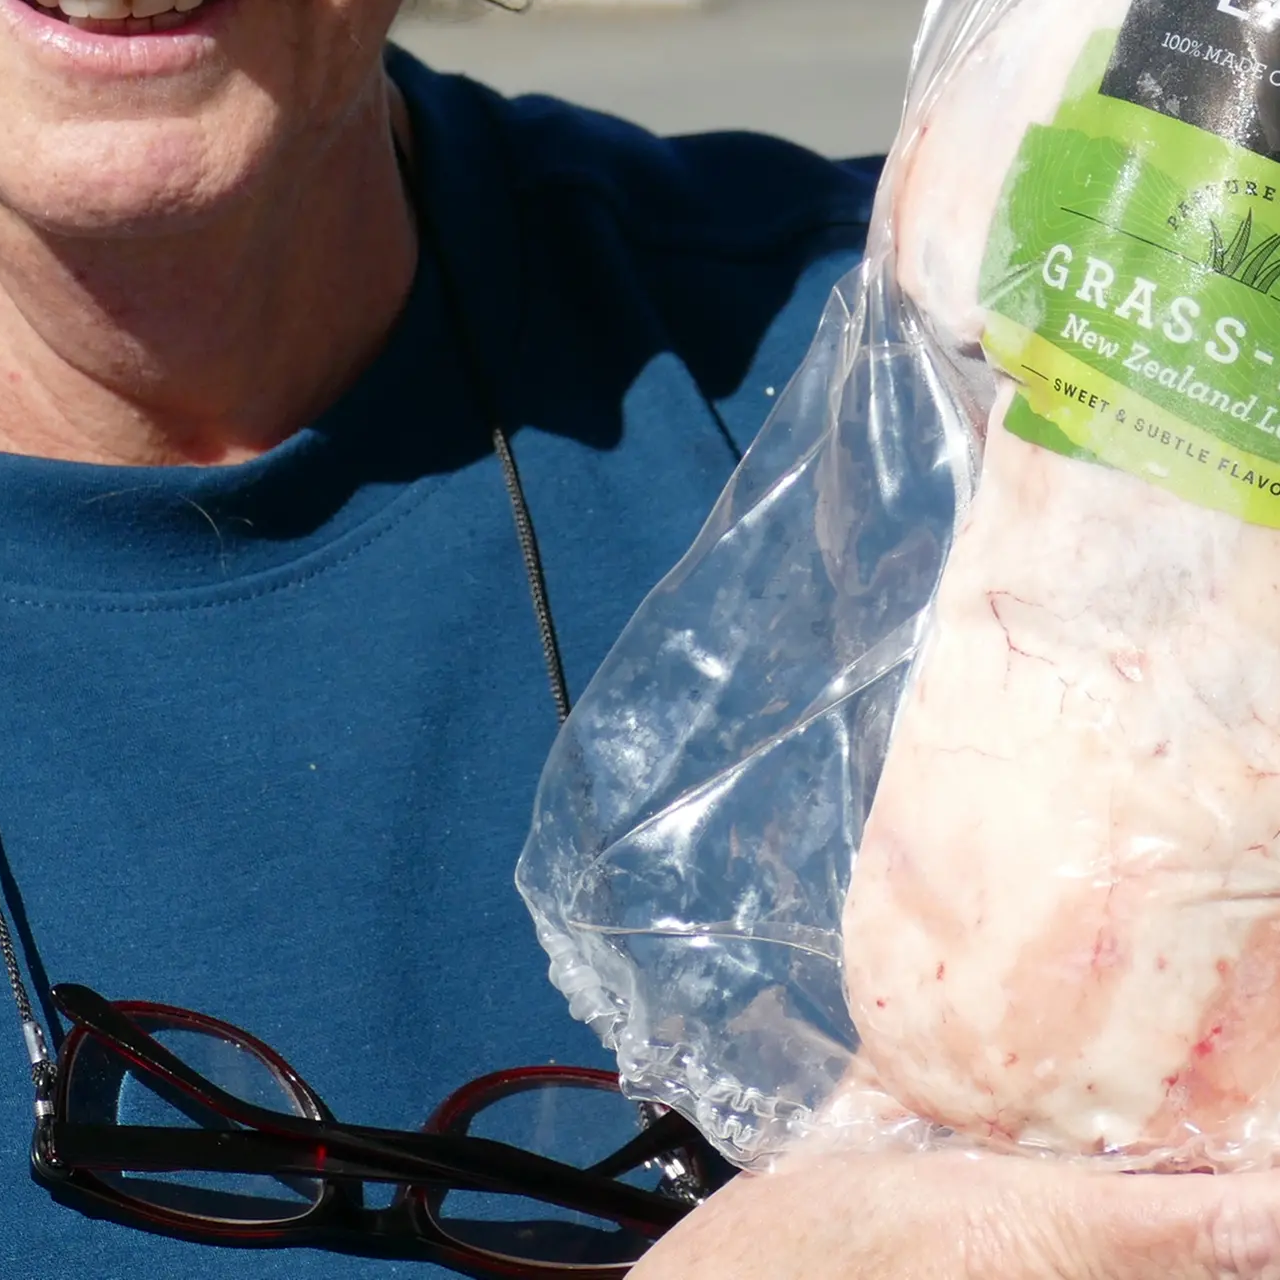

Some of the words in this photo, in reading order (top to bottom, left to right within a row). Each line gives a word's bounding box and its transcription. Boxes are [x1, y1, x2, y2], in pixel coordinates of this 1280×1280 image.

[1161, 32, 1204, 57] 100%
[1203, 45, 1268, 80] MADE
[1060, 312, 1120, 359] New
[1122, 341, 1259, 424] Zealand
[1053, 378, 1110, 413] SWEET
[1115, 408, 1128, 425] &
[1133, 417, 1211, 464] SUBTLE
